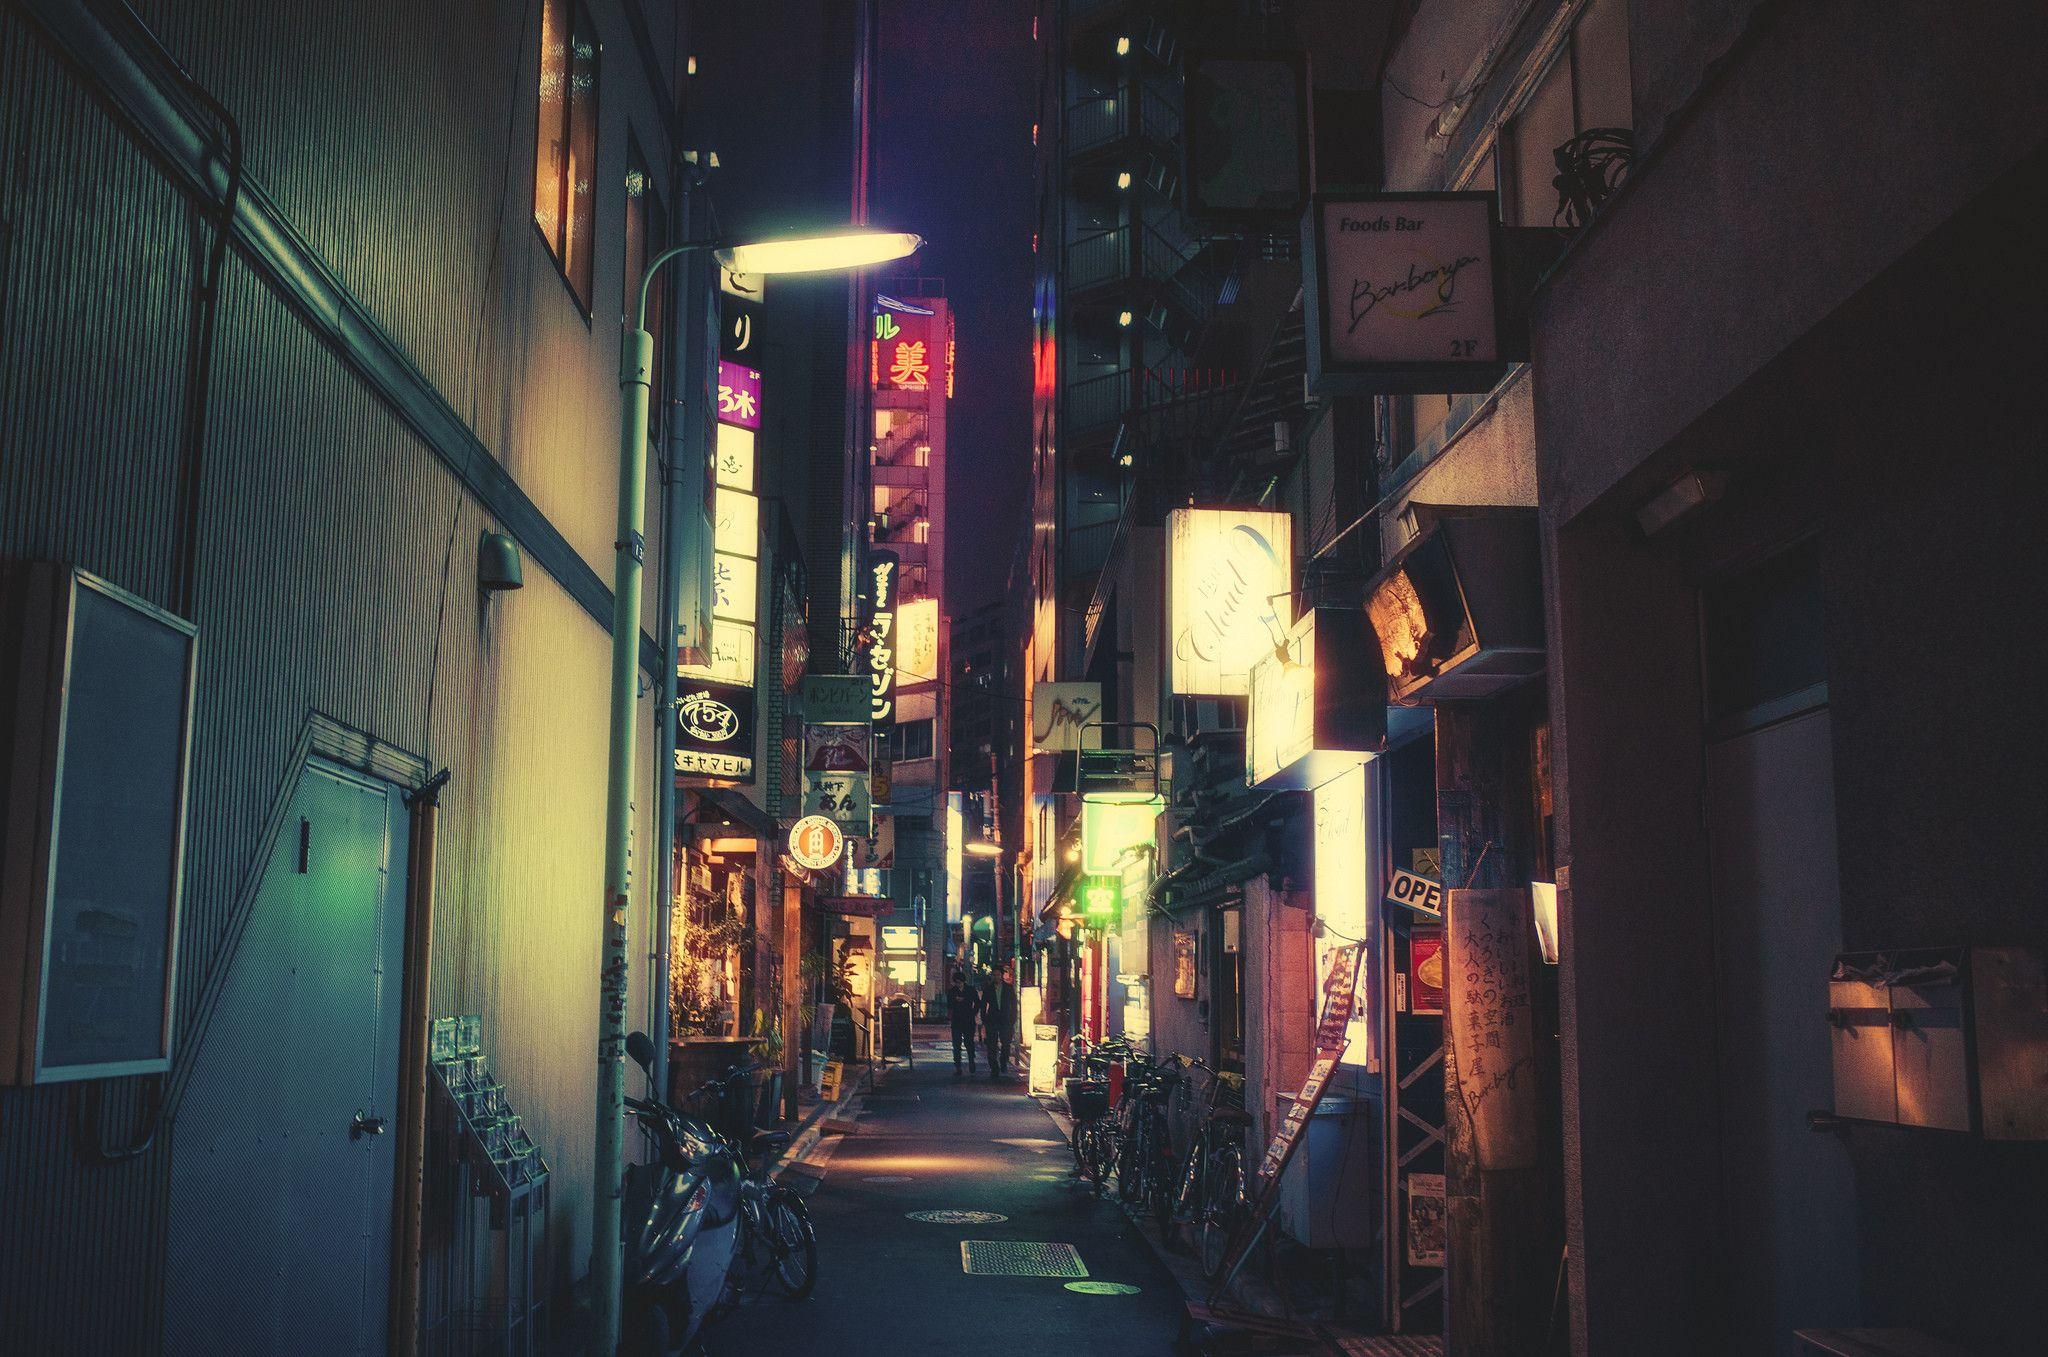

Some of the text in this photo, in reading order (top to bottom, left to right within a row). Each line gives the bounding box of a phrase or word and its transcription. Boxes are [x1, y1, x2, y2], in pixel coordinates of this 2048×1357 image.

[1340, 216, 1424, 232] Foods Bar
[890, 341, 930, 385] 美
[1449, 339, 1478, 357] 2F
[1394, 875, 1441, 912] OPE
[1481, 911, 1501, 1049] くつろぎの空間
[1464, 929, 1486, 1077] 大人の駄菓子屋
